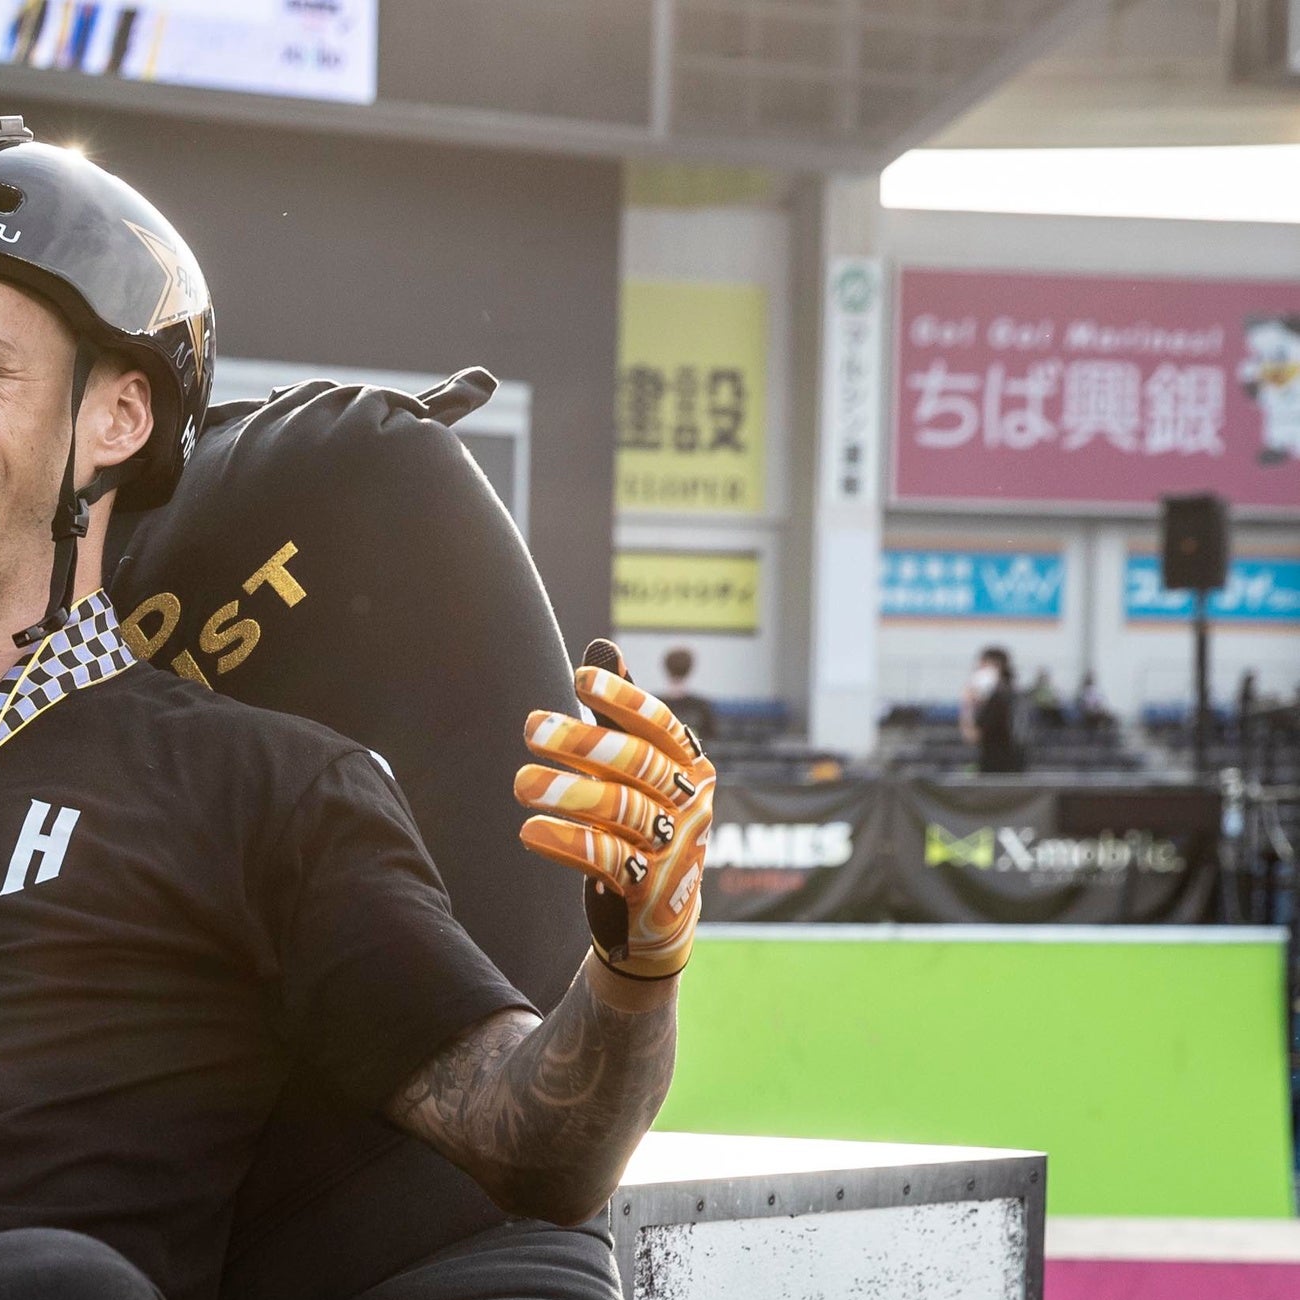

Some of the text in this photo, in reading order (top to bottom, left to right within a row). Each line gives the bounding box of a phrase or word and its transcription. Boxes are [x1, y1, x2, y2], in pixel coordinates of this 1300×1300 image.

[906, 357, 1226, 455] ちば興銀
[0, 798, 81, 897] H
[704, 821, 854, 869] AMES
